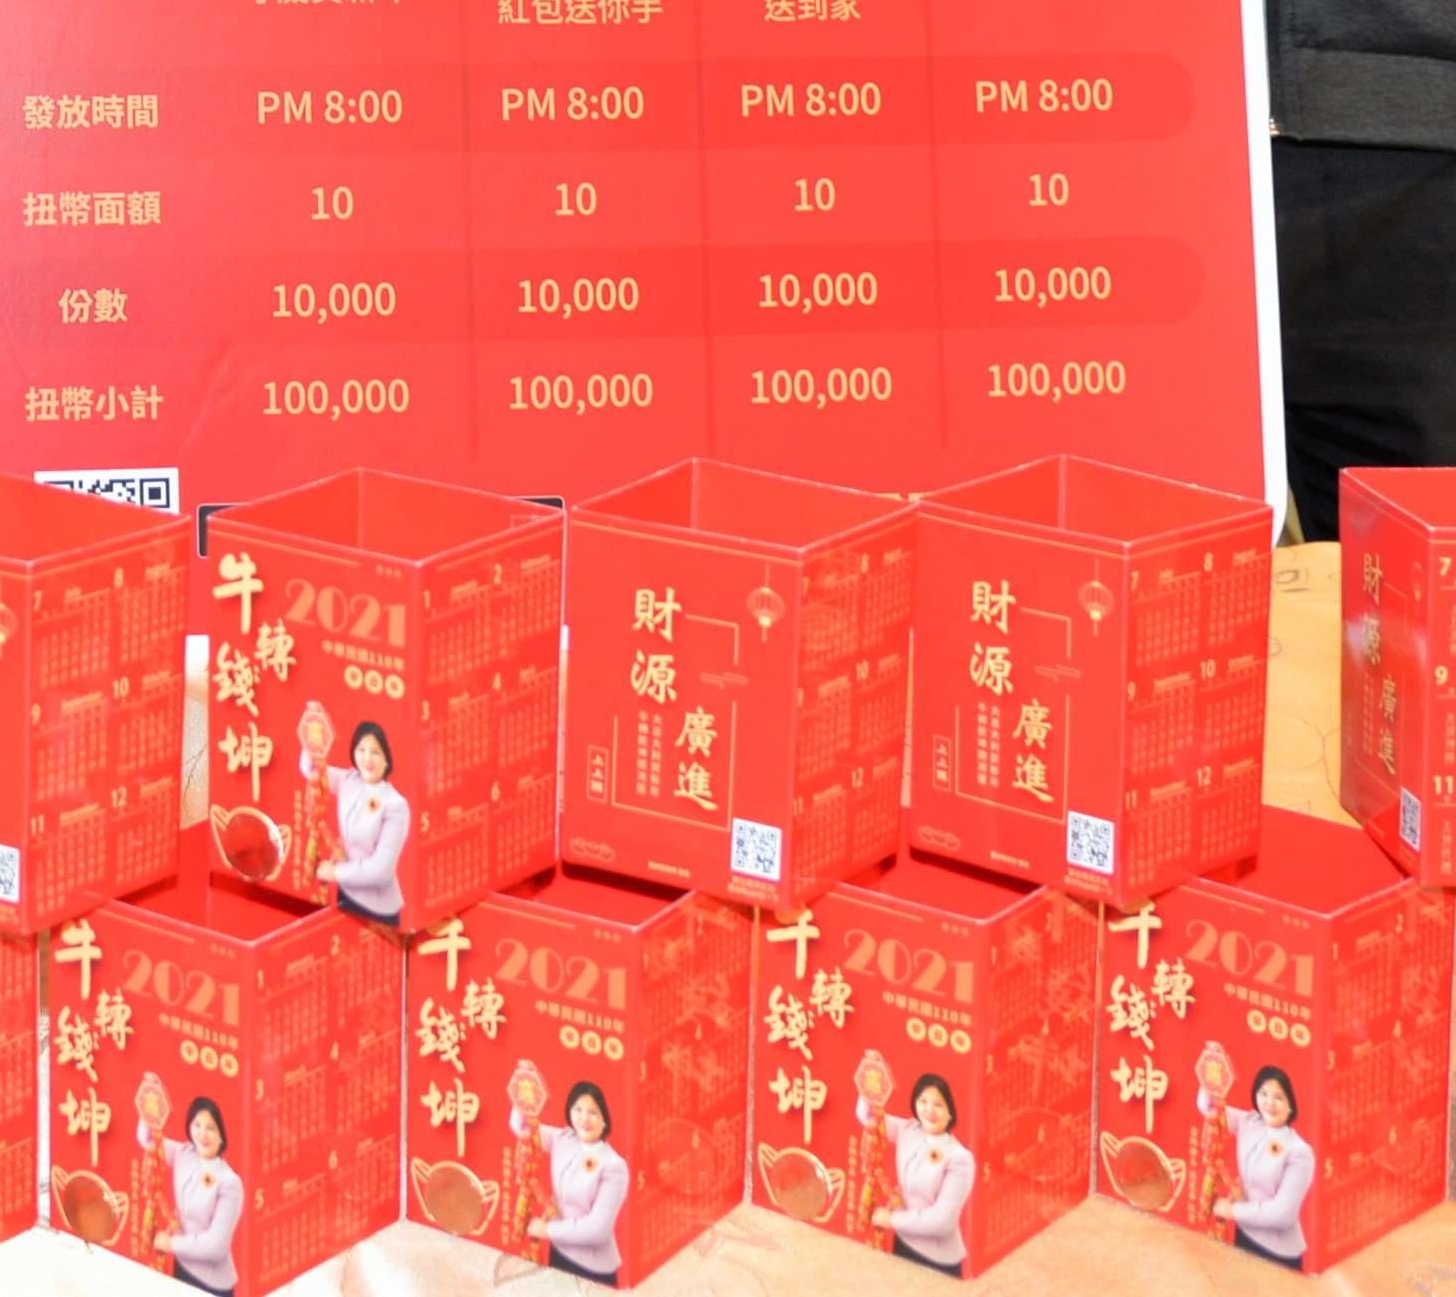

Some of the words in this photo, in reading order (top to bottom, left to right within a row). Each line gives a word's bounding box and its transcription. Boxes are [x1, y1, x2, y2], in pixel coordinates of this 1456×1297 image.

[21, 94, 159, 130] 發放時間
[257, 91, 312, 124] PM
[324, 89, 403, 124] 8:00
[501, 87, 556, 121] PM
[567, 86, 644, 121] 8:00
[741, 84, 794, 117] PM
[805, 82, 882, 117] 8:00
[975, 79, 1028, 113] PM
[1038, 78, 1113, 112] 8:00
[22, 191, 161, 227] 扭幣面額
[311, 186, 354, 220] 10
[555, 182, 597, 216] 10
[794, 177, 836, 212] 10
[1029, 172, 1069, 207] 10
[58, 287, 128, 324] 份數
[272, 282, 396, 325] 10,000
[518, 277, 639, 319] 10,000
[759, 271, 878, 314] 10,000
[995, 266, 1112, 309] 10,000
[24, 384, 164, 422] 扭幣小計
[263, 378, 410, 421] 100,000
[509, 373, 653, 416] 100,000
[751, 366, 892, 409] 100,000
[988, 360, 1126, 403] 100,000
[1438, 557, 1452, 576] 7
[284, 577, 407, 647] 2021
[1362, 552, 1384, 669] 財源
[630, 586, 683, 705] 財源
[969, 579, 1018, 697] 財源
[1435, 666, 1448, 685] 9
[1377, 671, 1400, 777] 廣進
[673, 704, 718, 811] 廣進
[1011, 697, 1054, 802] 廣進
[1433, 775, 1455, 795] 11
[494, 937, 628, 1010] 2021
[843, 928, 975, 1004] 2021
[1185, 918, 1315, 998] 2021
[120, 948, 241, 1027] 2021
